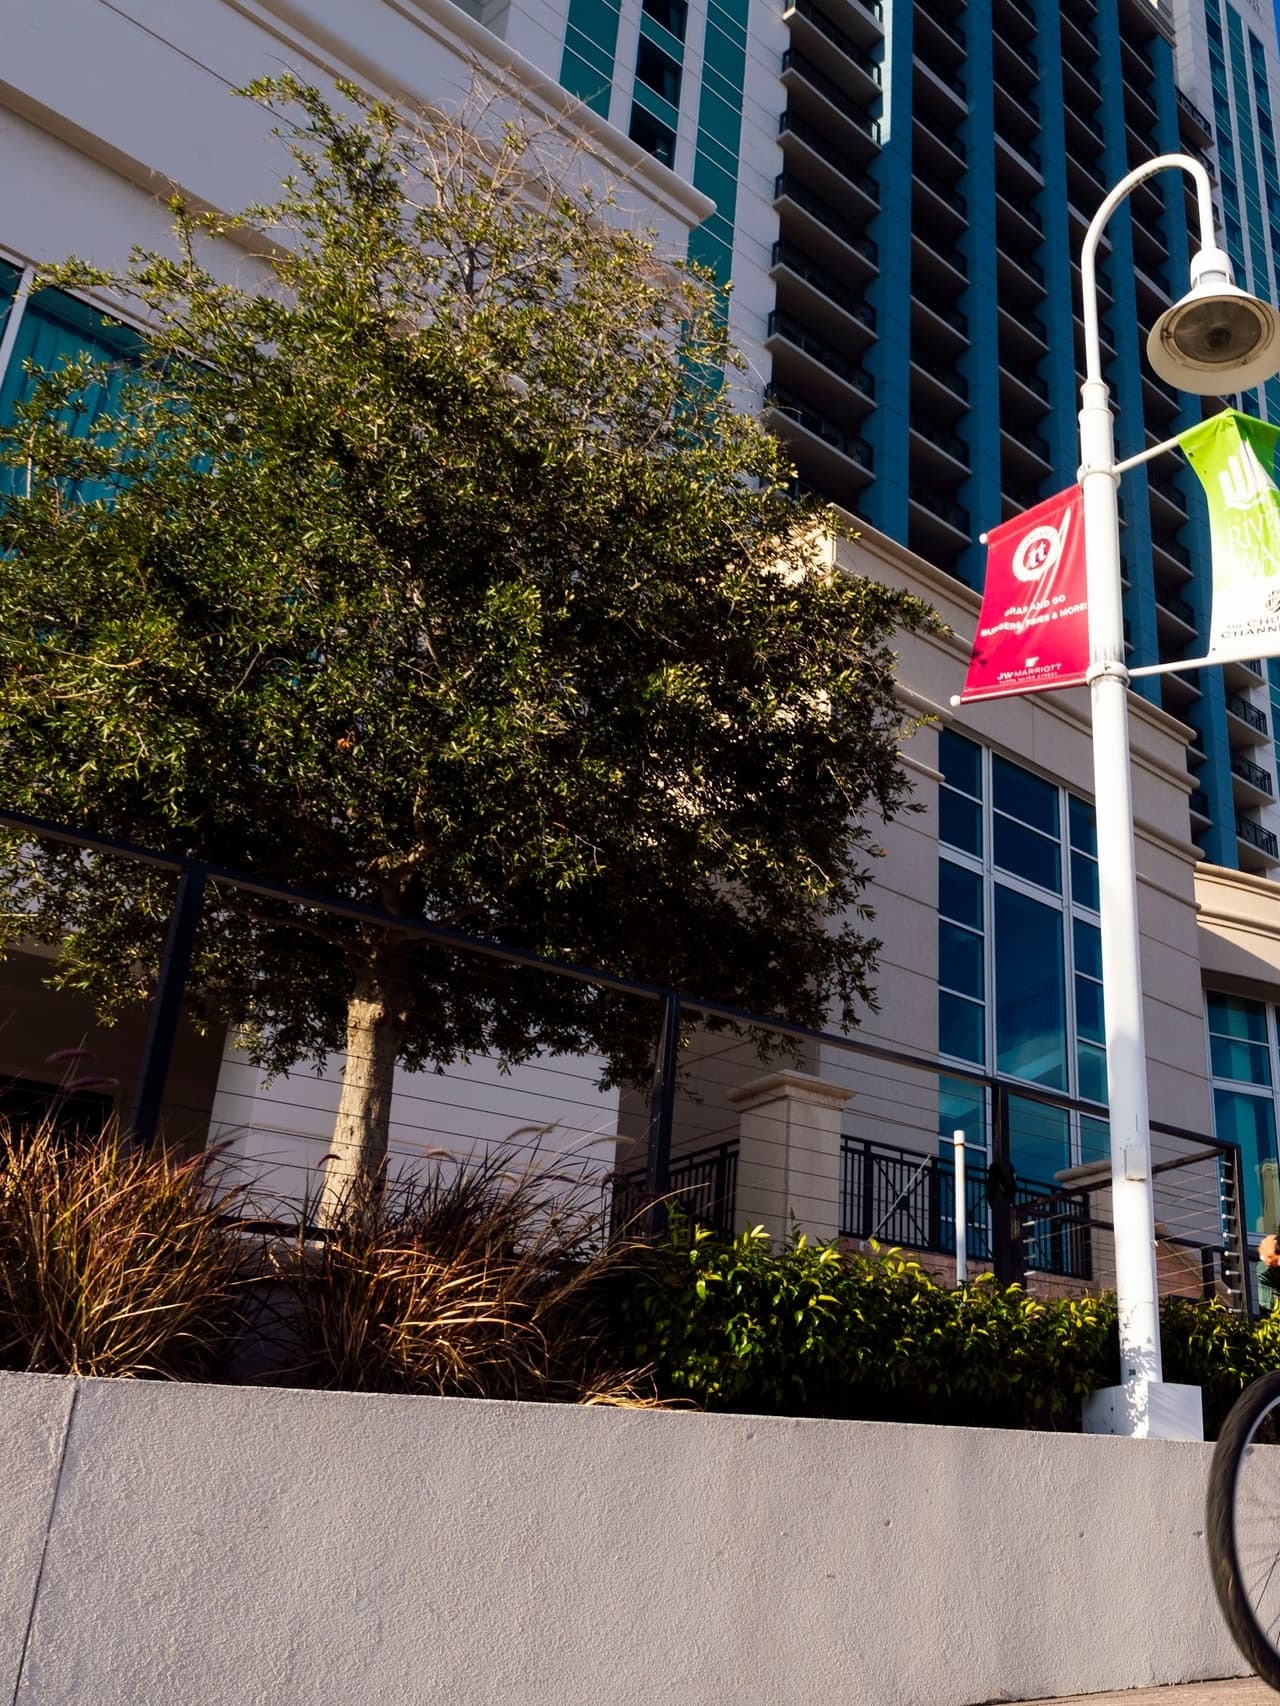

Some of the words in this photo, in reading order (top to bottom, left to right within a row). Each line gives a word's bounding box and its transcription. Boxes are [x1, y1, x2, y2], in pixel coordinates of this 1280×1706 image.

[1029, 600, 1051, 610] AND
[1052, 594, 1067, 605] GO
[997, 671, 1014, 681] JW
[1014, 663, 1063, 677] MARRIOTT
